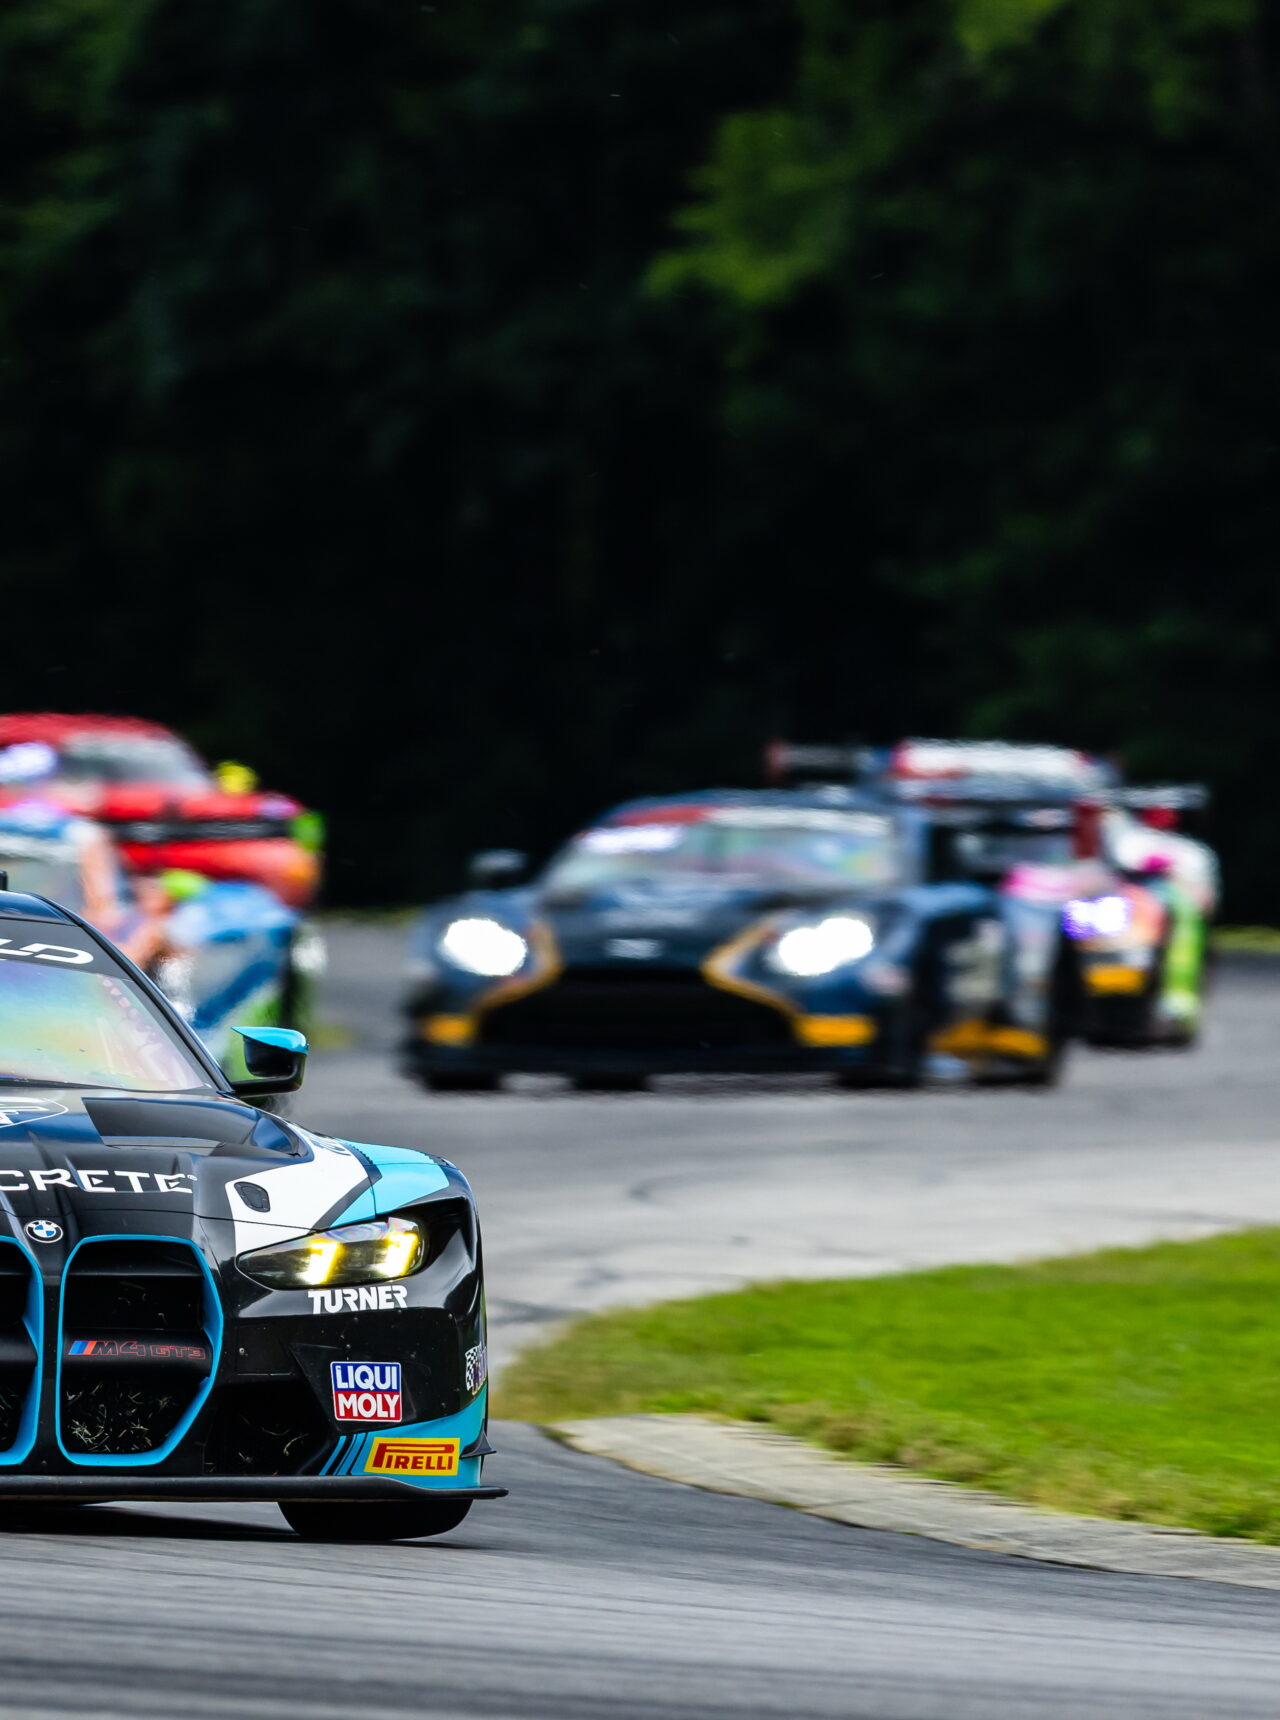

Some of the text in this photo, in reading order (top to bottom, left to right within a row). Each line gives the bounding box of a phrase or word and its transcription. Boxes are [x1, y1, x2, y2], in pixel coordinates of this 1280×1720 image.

[307, 1284, 409, 1315] TURNER
[149, 1343, 207, 1361] GT3
[335, 1364, 399, 1392] LIQUI
[337, 1393, 402, 1419] MOLY
[371, 1442, 456, 1471] PIRELLI
